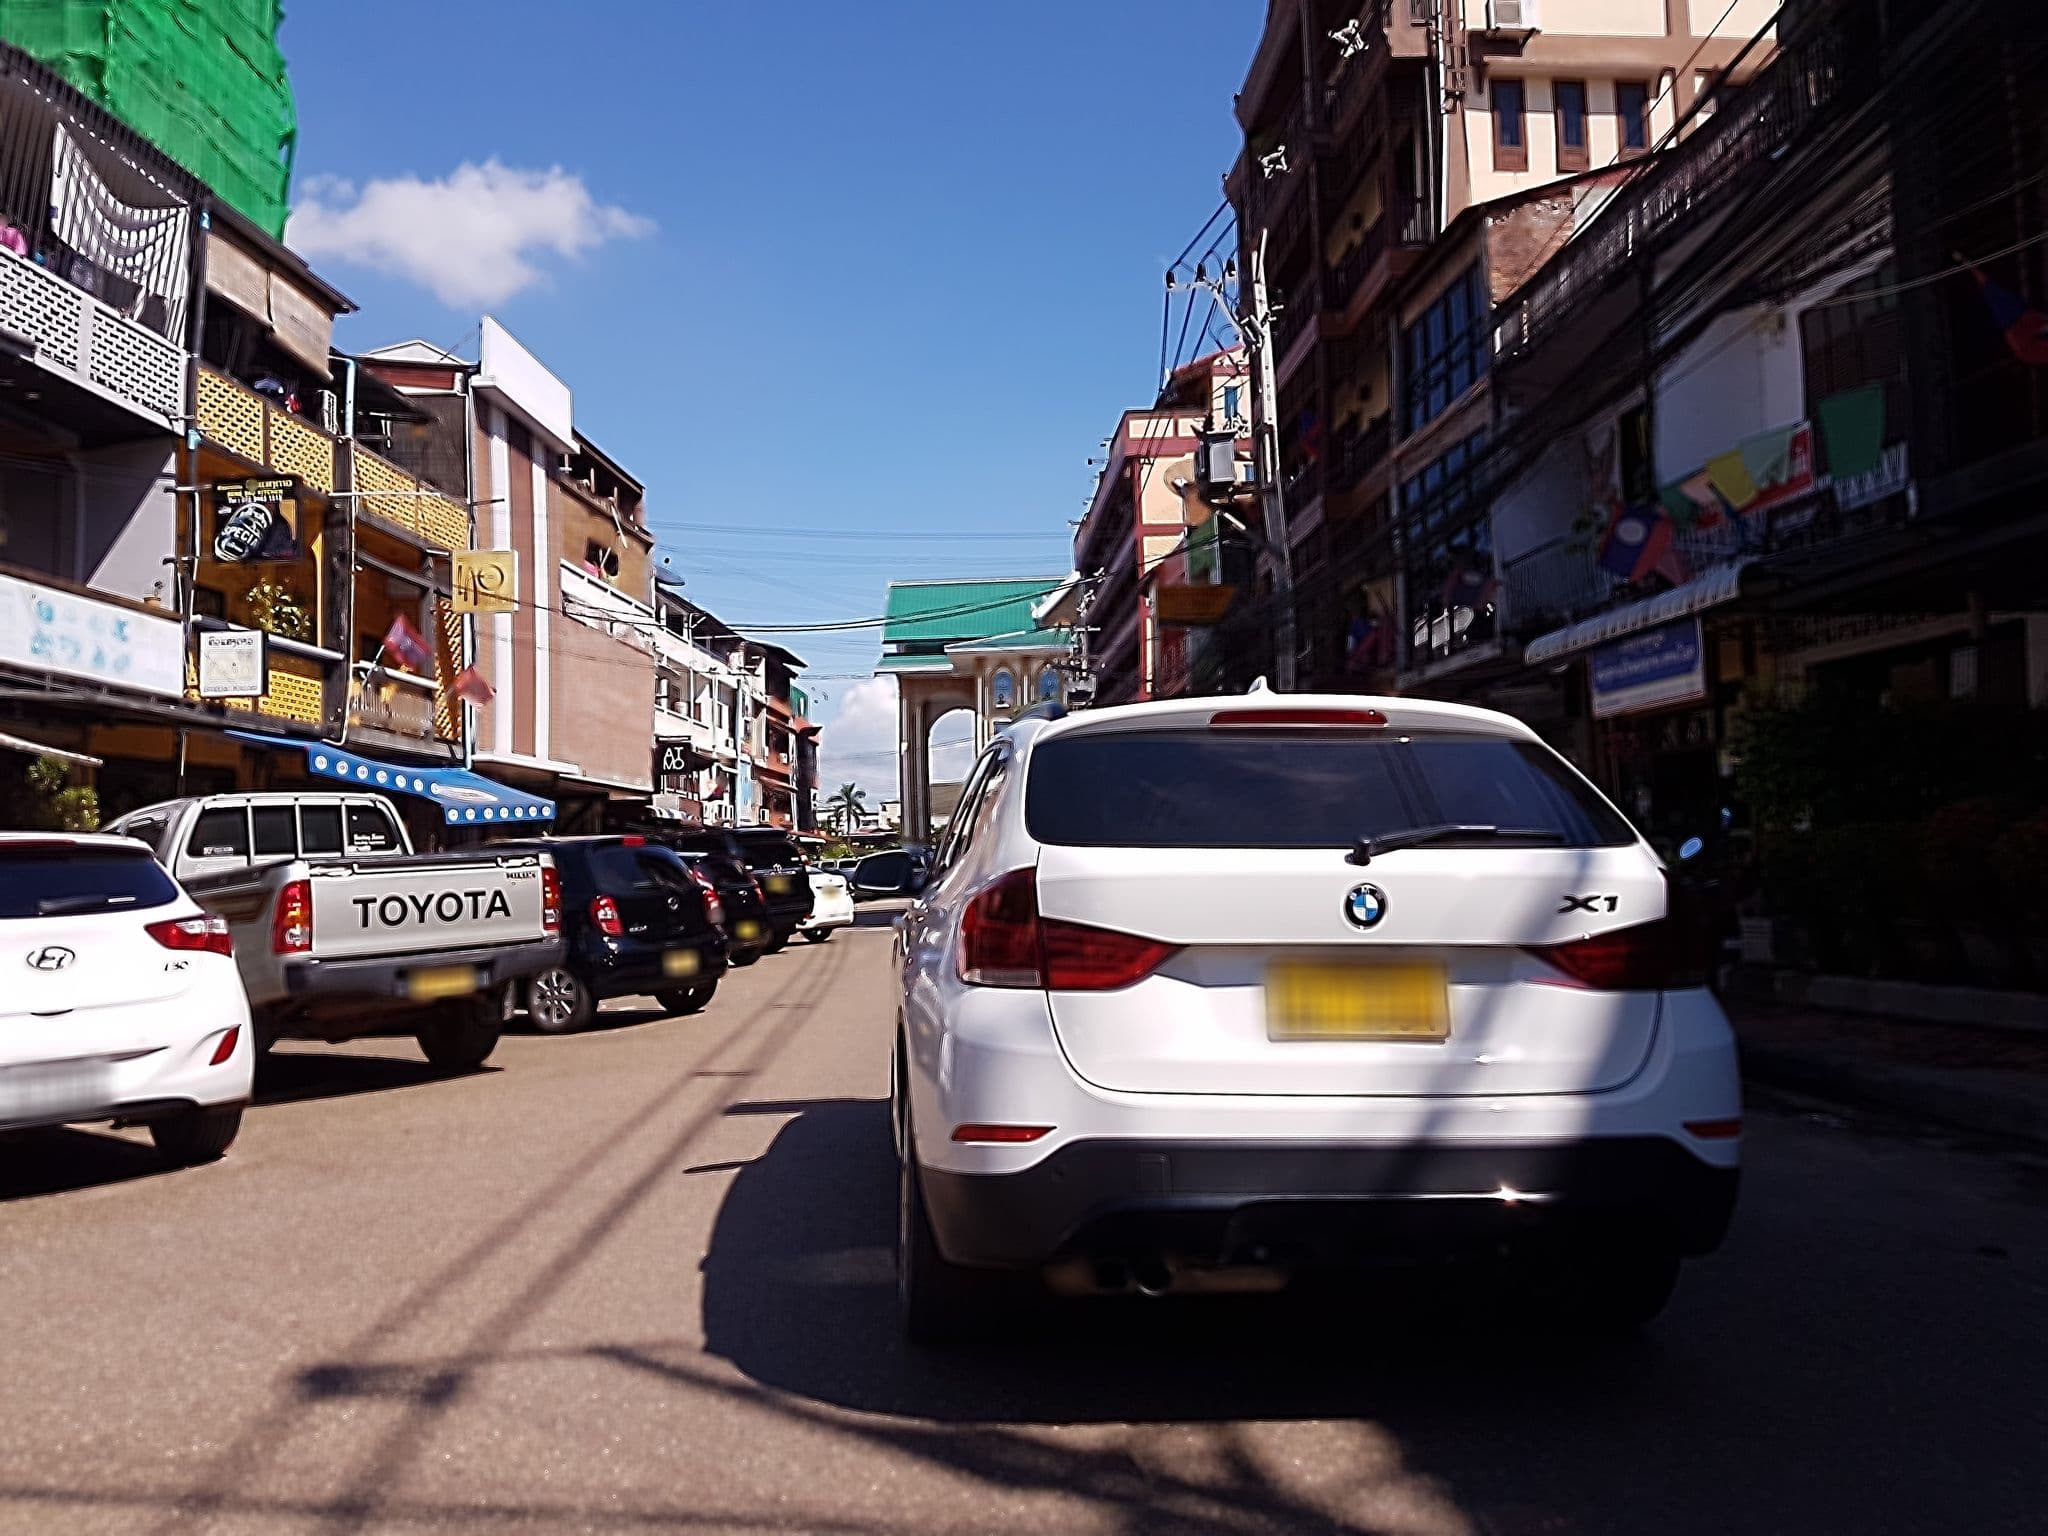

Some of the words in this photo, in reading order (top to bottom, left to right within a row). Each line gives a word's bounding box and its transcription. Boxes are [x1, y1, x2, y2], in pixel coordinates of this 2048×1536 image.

[221, 526, 259, 547] SPECIA
[352, 890, 511, 928] TOYOTA
[1557, 895, 1618, 913] X1
